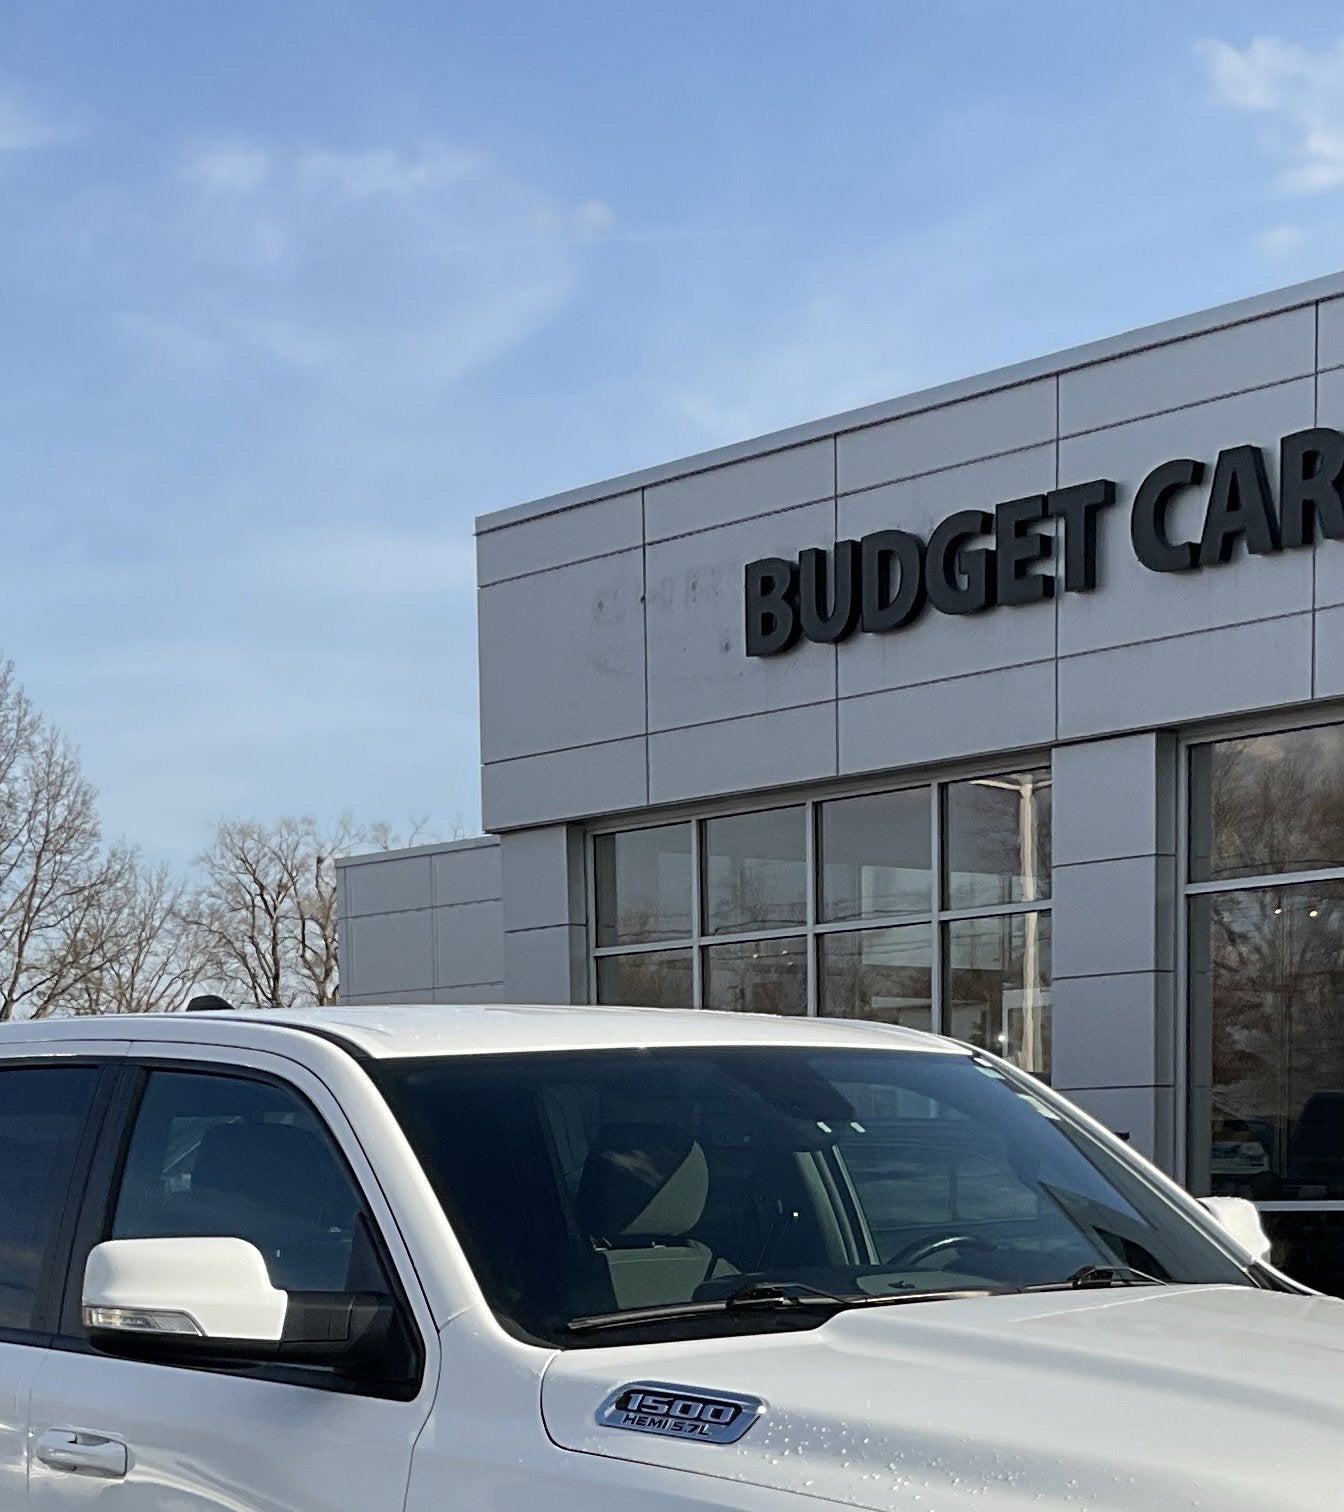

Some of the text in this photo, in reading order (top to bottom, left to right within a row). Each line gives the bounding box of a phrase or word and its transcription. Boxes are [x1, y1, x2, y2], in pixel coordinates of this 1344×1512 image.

[745, 479, 1115, 657] BUDGET
[627, 1393, 735, 1423] 1500
[622, 1413, 710, 1436] HEMI 5.7L
